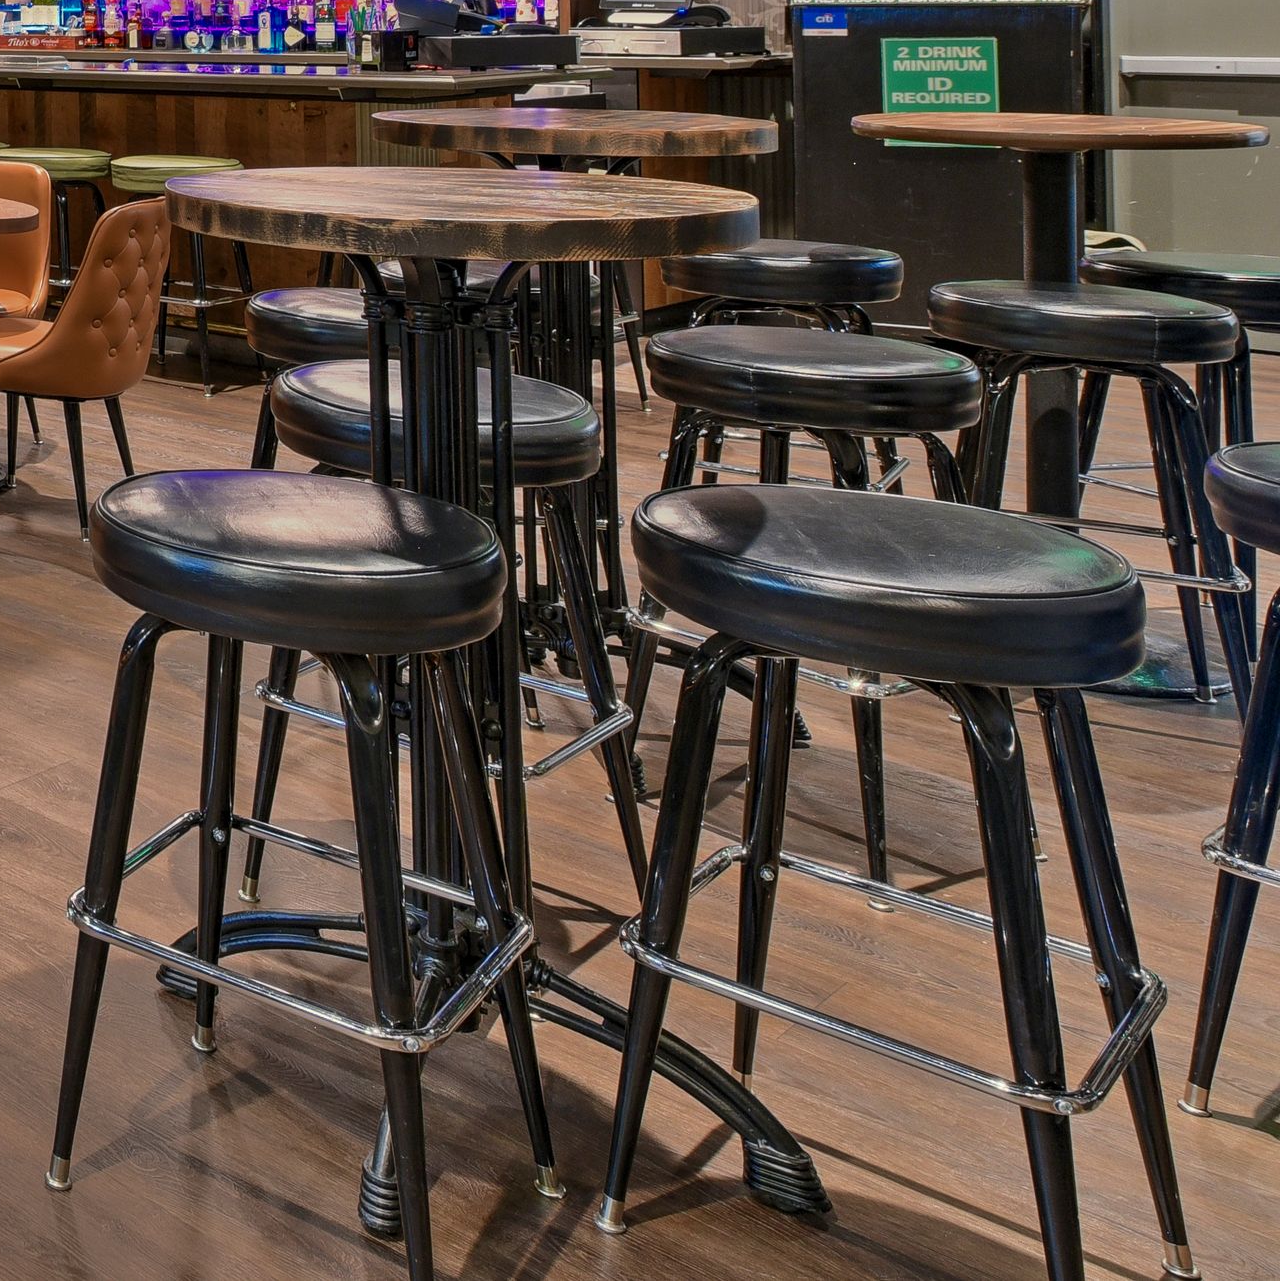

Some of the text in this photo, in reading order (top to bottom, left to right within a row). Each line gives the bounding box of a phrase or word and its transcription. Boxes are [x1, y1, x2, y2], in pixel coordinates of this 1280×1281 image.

[815, 14, 834, 23] citi
[7, 37, 30, 47] Tito's
[897, 46, 982, 58] 2 DRINK
[893, 59, 988, 71] MINIMUM
[927, 77, 953, 91] ID
[891, 92, 992, 105] REQUIRED
